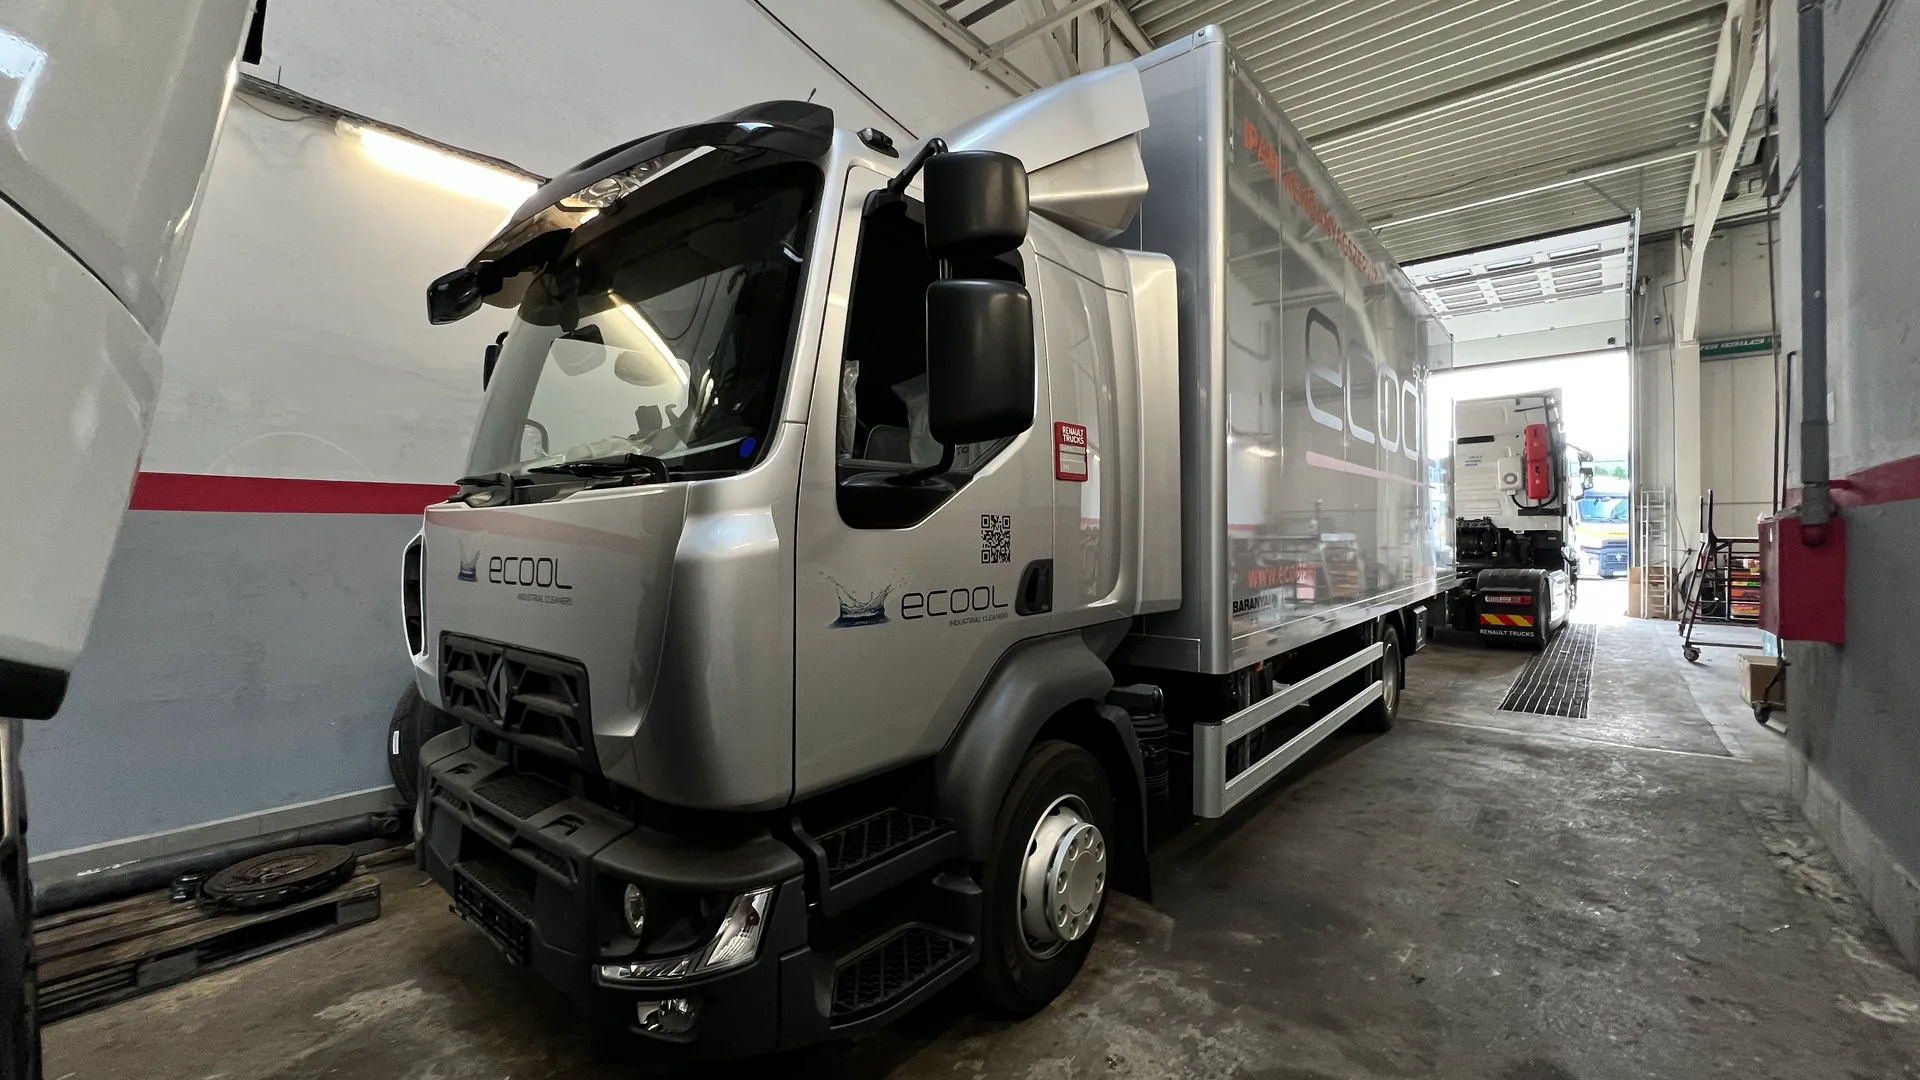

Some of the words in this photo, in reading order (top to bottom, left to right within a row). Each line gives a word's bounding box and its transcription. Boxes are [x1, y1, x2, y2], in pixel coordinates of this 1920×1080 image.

[1062, 426, 1084, 437] RENAULT
[1063, 434, 1085, 445] TRUCKS
[545, 596, 573, 605] CLEANERS
[949, 616, 981, 627] INDUSTRIAL
[982, 612, 1009, 622] CLEANERS
